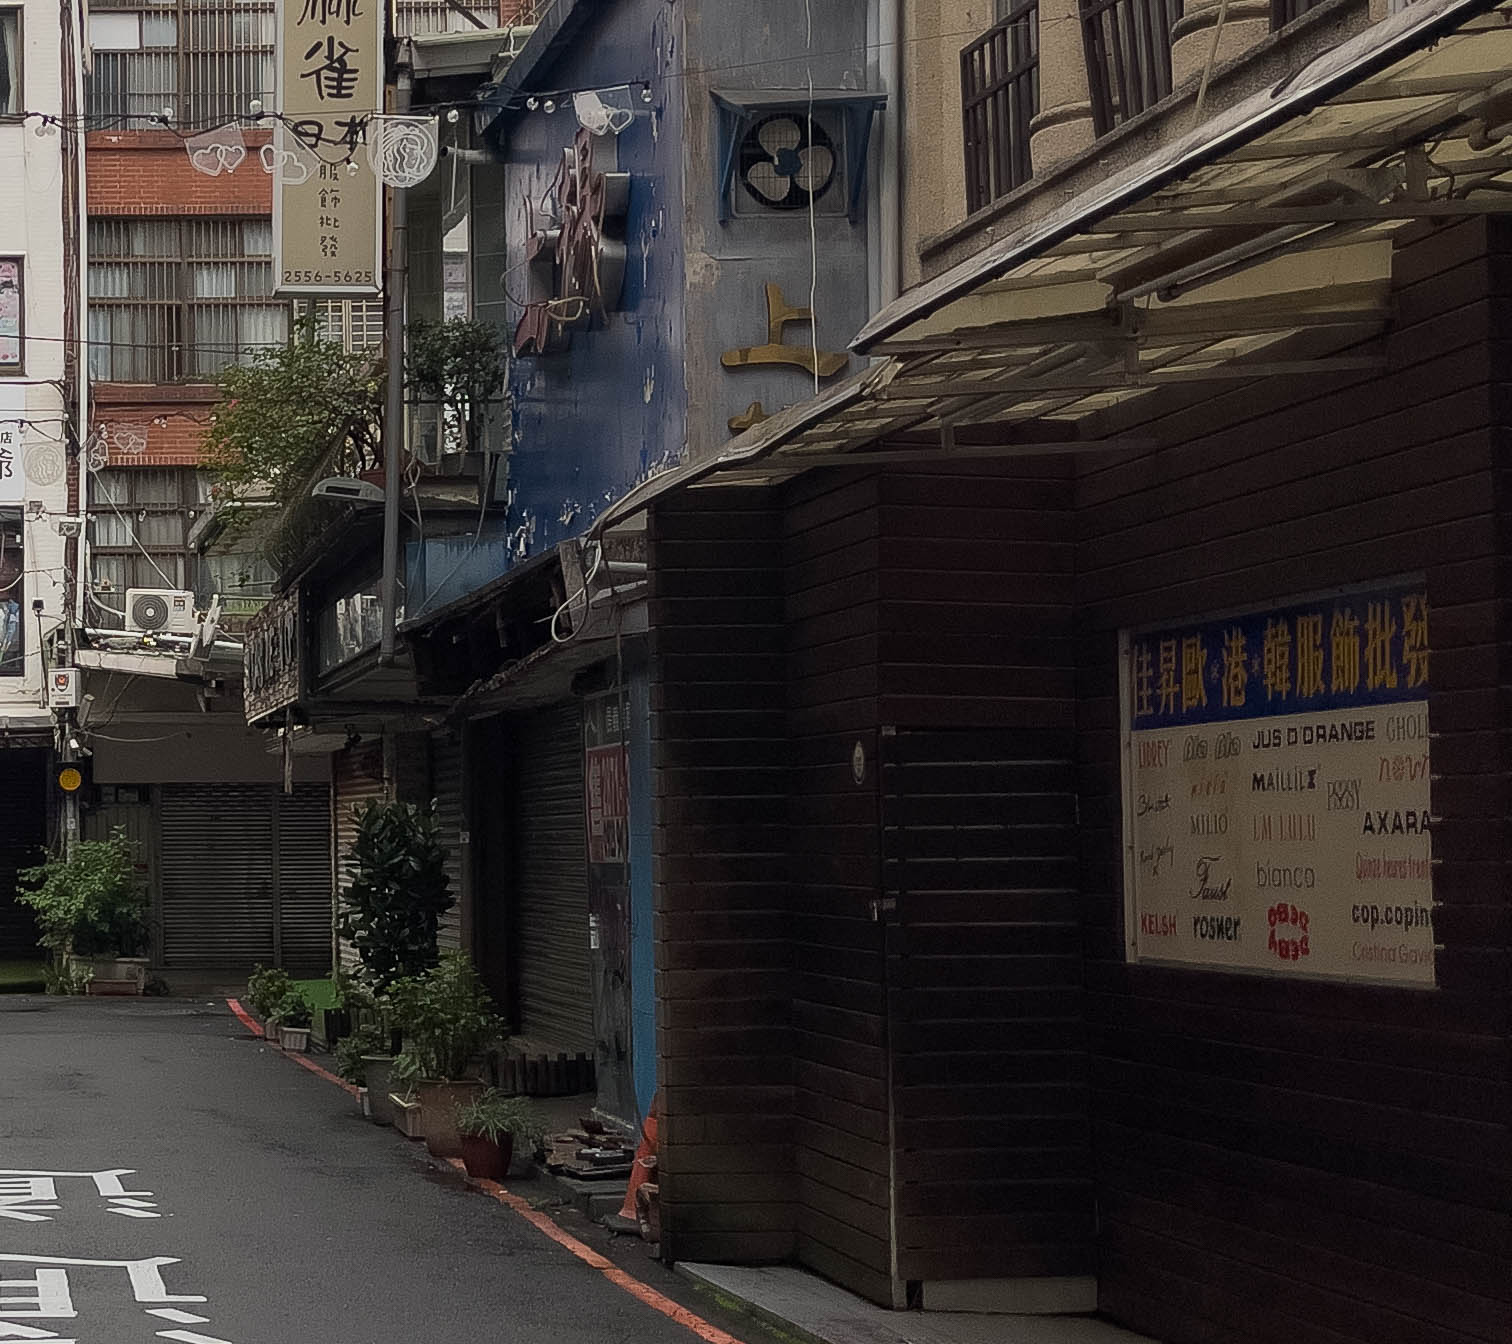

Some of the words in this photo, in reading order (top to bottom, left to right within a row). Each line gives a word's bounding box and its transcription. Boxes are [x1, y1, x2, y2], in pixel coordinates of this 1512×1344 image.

[318, 163, 341, 257] 服飾批發
[283, 269, 373, 284] 2556-5625
[1252, 728, 1281, 750] JUS
[1362, 810, 1432, 836] AXARA
